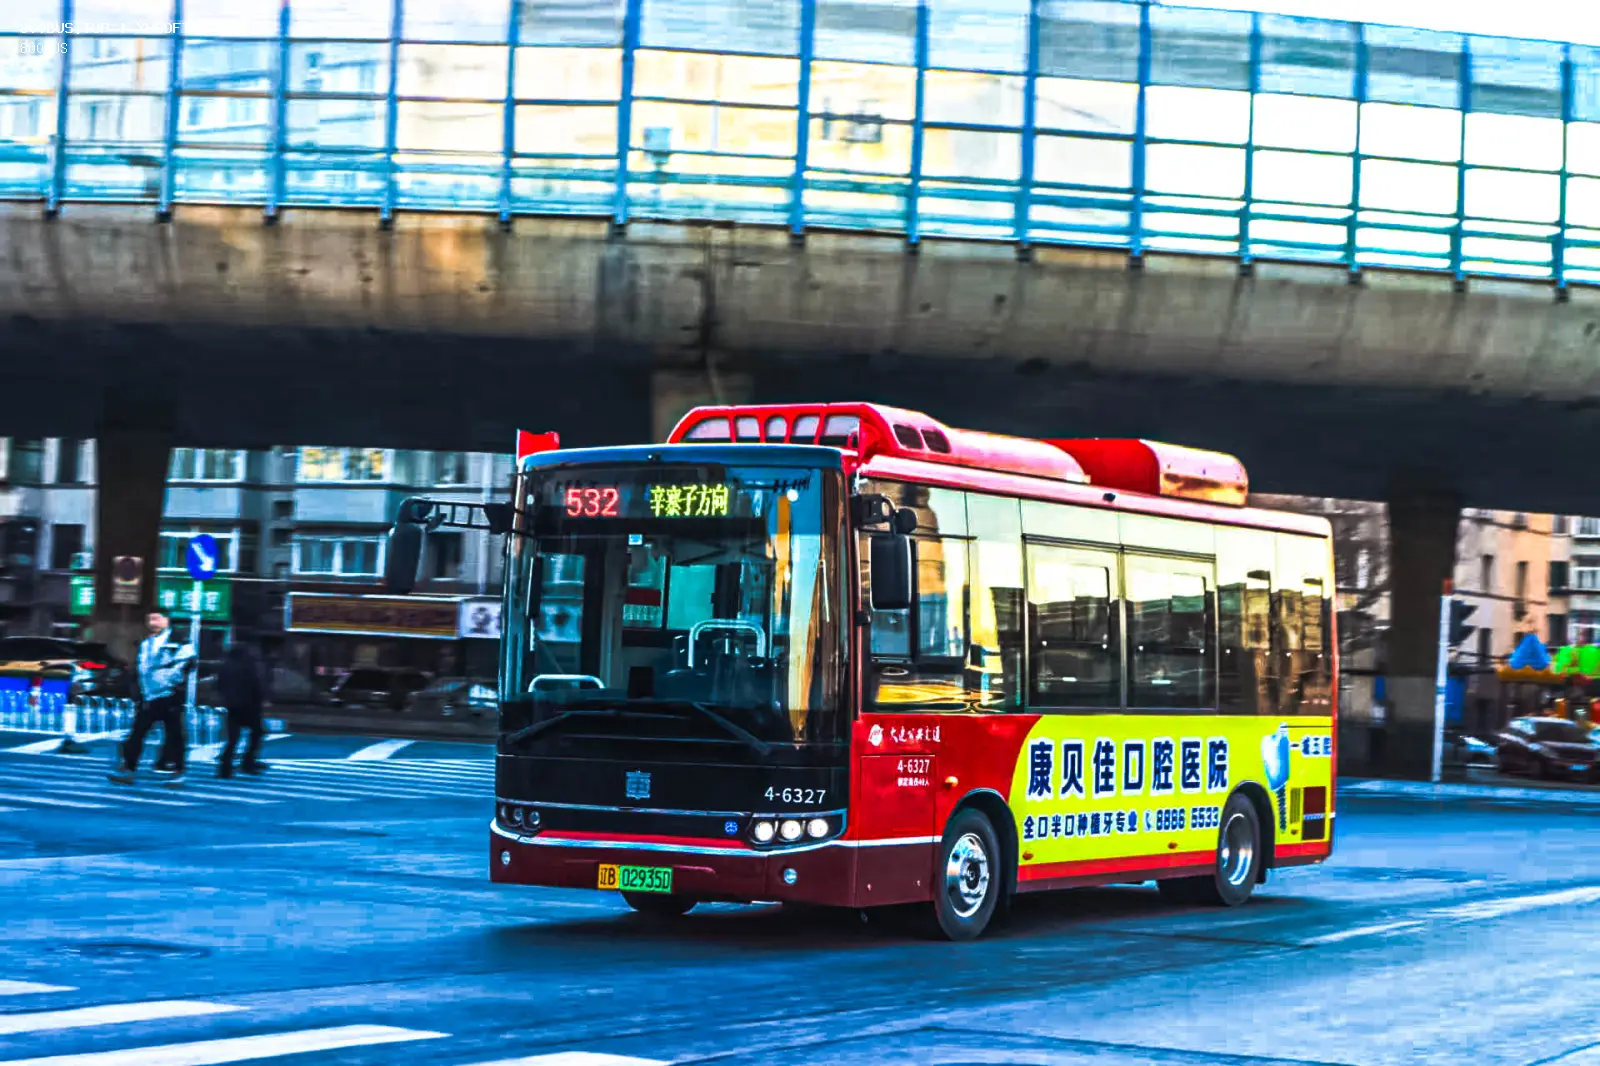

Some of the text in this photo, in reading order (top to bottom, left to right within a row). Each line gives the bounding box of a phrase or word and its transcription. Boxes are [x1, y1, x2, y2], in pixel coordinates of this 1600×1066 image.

[565, 488, 619, 517] 532
[650, 483, 729, 517] 辛寨子方向
[897, 759, 930, 774] 4-6327
[1027, 739, 1229, 797] 康贝佳口腔医院
[764, 786, 826, 805] 4-6327
[1023, 806, 1219, 840] 全口半口种植牙专业 8886 5533
